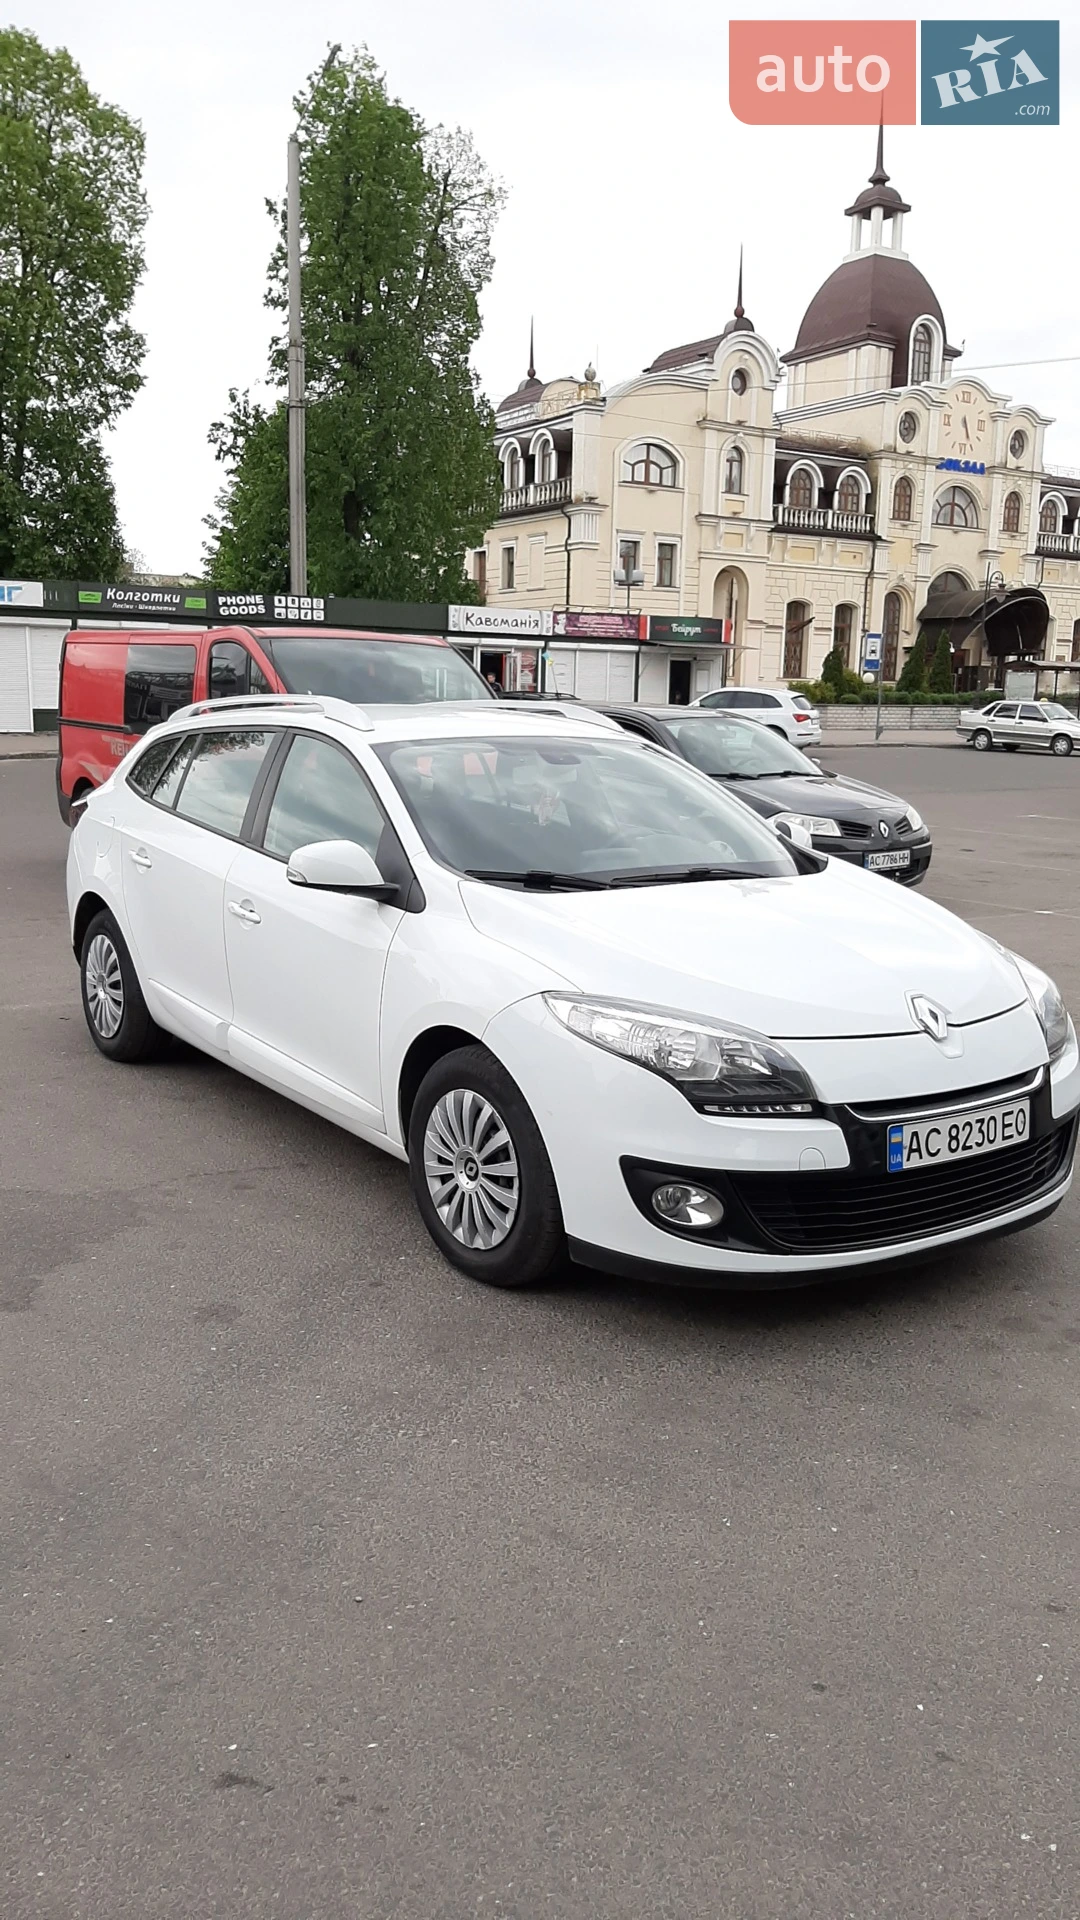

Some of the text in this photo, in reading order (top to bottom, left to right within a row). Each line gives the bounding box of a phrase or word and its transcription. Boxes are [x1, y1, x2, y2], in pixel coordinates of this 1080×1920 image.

[106, 587, 181, 604] Колготки
[217, 594, 264, 606] PHONE
[219, 604, 266, 616] GOODS
[465, 612, 540, 629] Кавоманія
[890, 1153, 902, 1164] UA
[906, 1127, 942, 1162] AC
[947, 1115, 998, 1154] 8230
